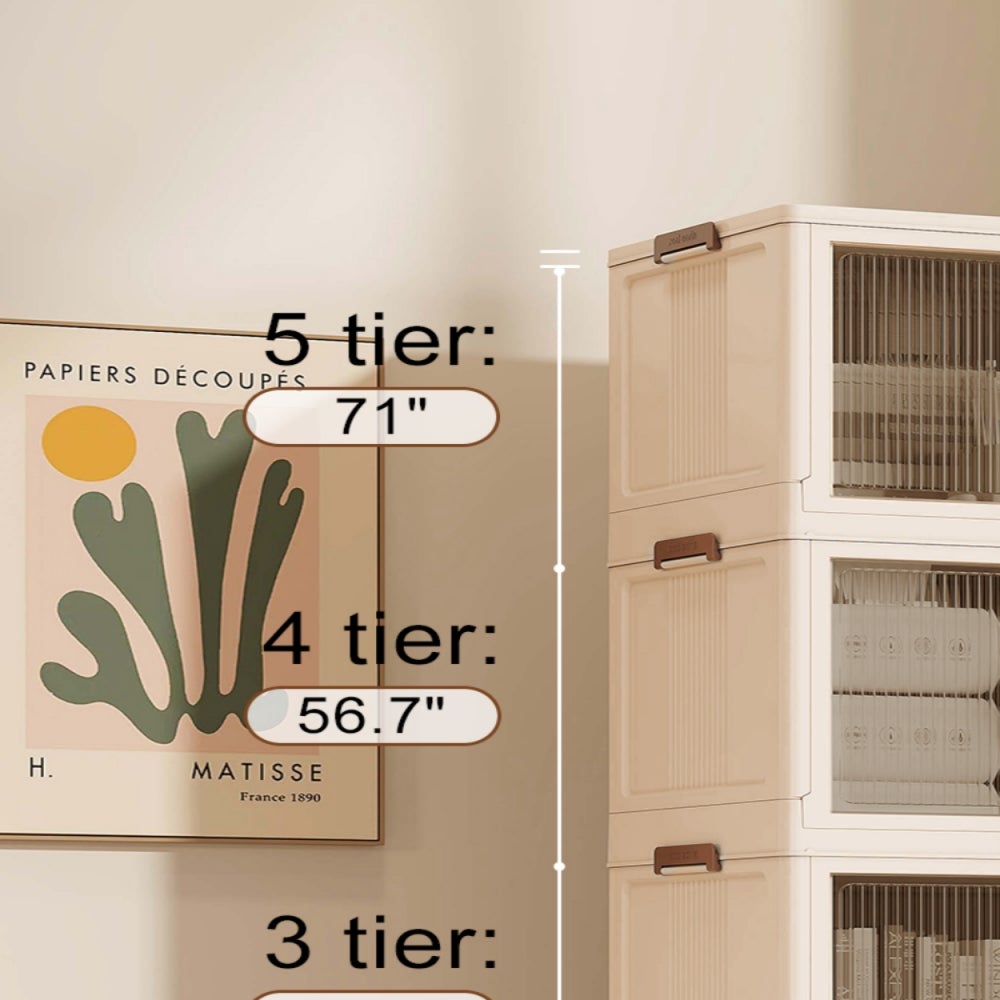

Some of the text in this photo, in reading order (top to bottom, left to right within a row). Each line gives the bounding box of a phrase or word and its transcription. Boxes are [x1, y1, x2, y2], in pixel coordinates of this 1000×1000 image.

[25, 362, 306, 390] PAPIERS DÉCOUPÉS
[29, 757, 322, 782] H. MATISSE
[240, 792, 322, 803] France 1890
